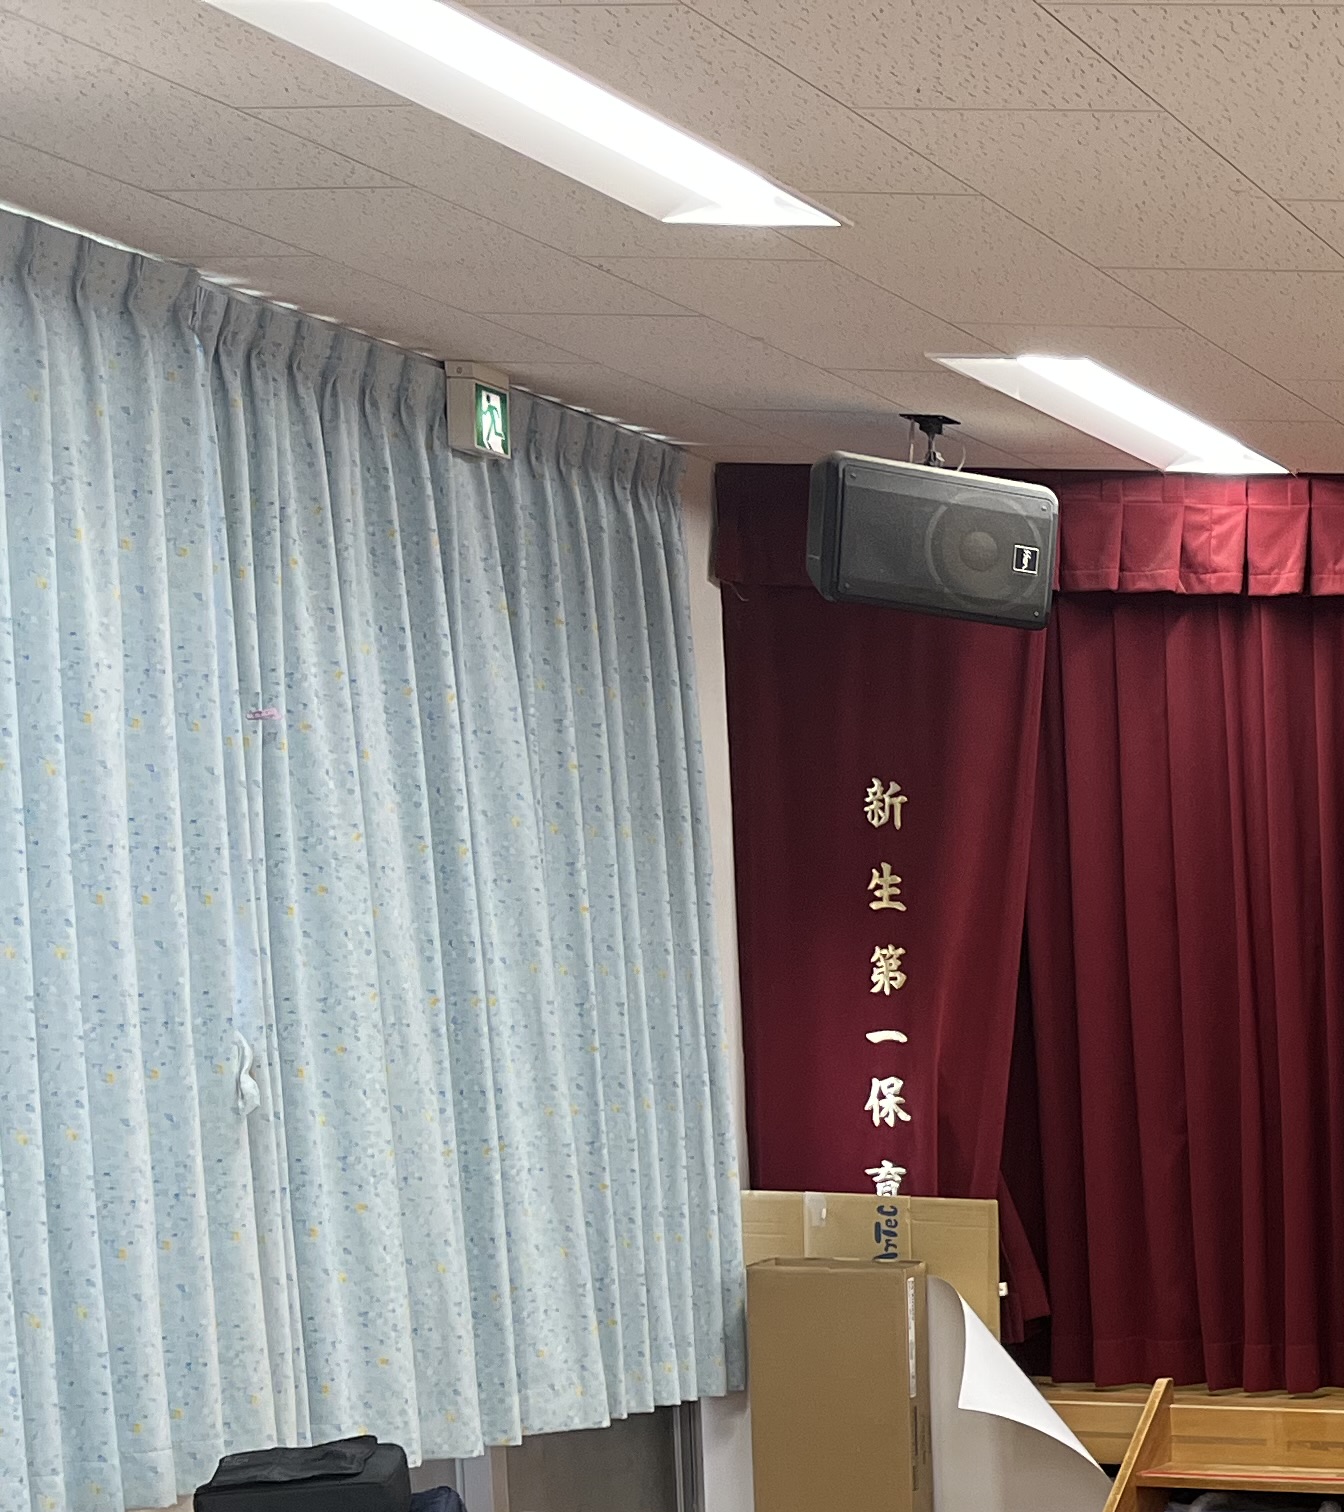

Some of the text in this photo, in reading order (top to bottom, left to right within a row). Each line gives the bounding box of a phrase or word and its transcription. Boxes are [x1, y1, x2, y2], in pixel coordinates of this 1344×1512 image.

[863, 777, 911, 1197] 新生第一保育
